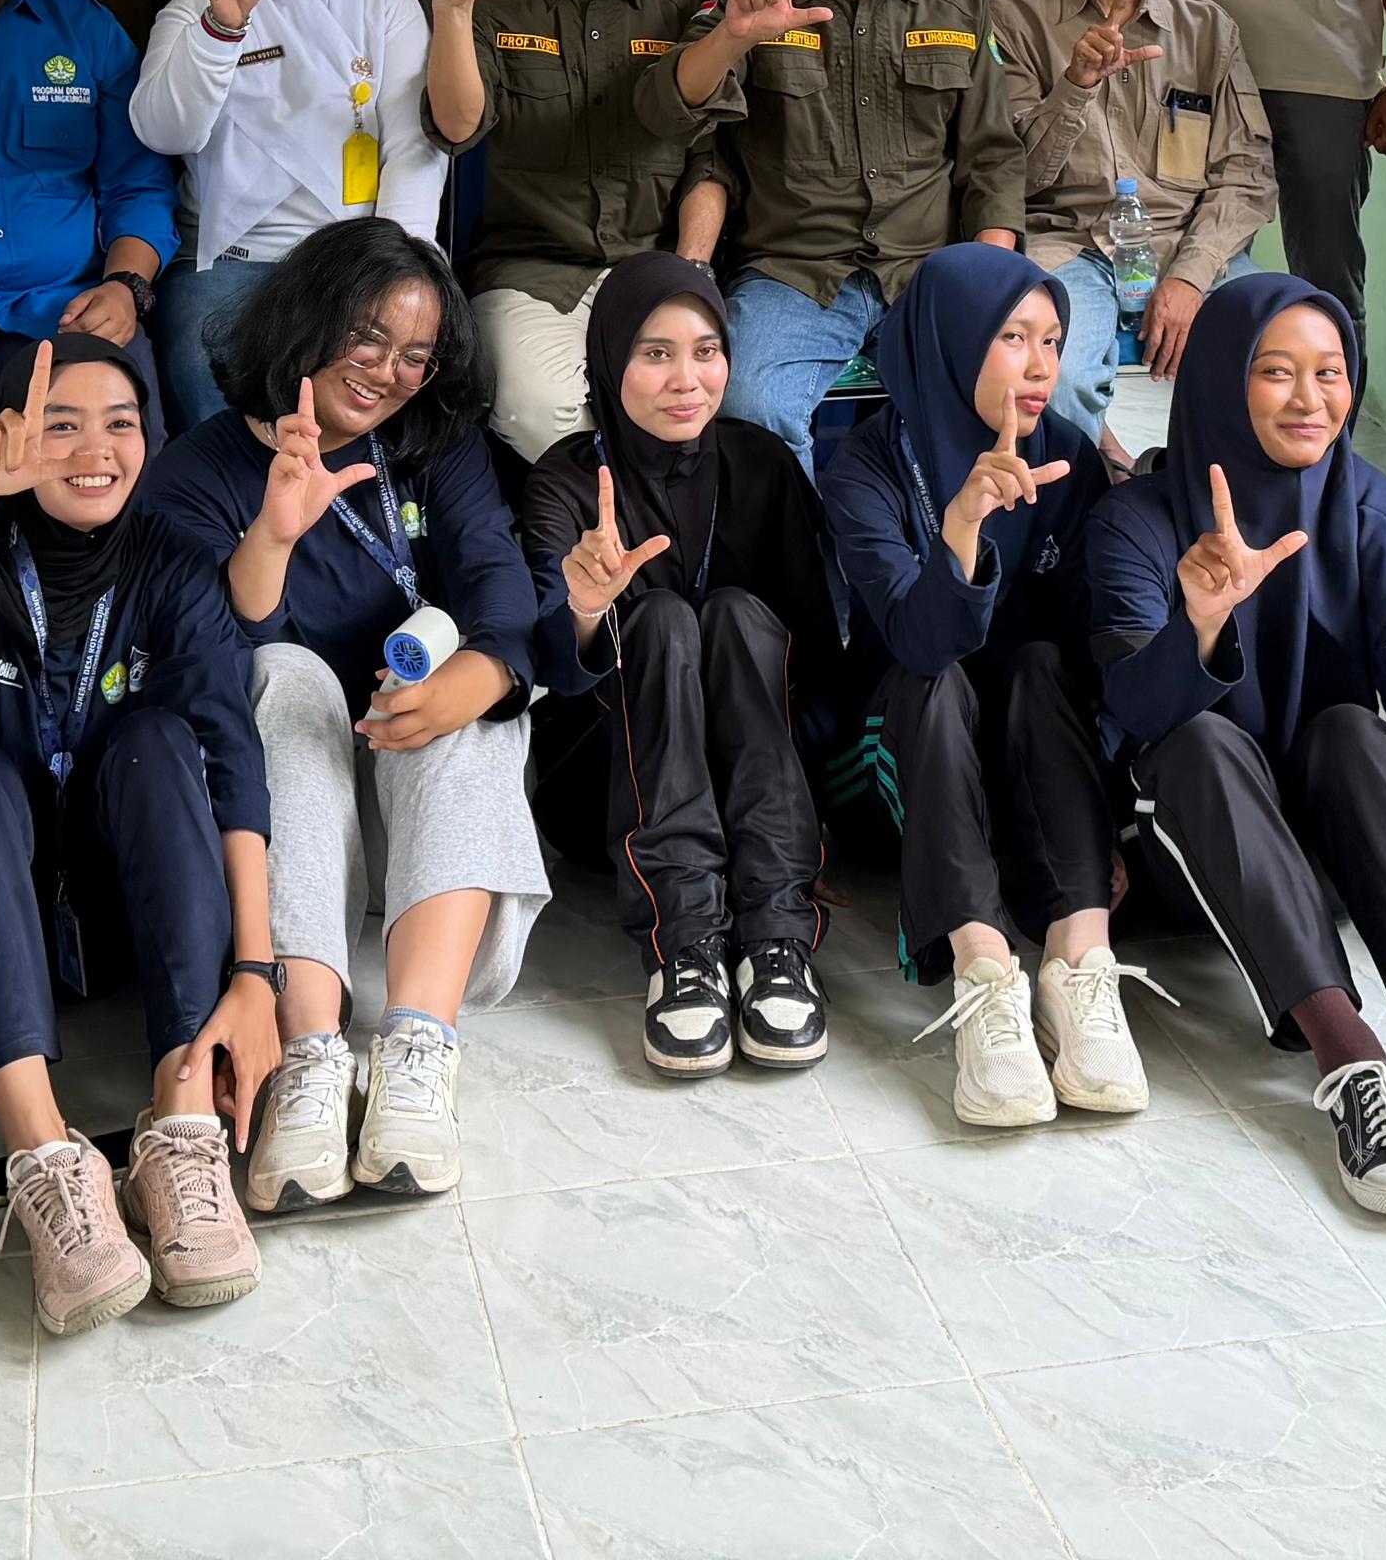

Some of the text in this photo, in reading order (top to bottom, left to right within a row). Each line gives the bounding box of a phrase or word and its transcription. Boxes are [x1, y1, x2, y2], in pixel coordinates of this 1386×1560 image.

[501, 36, 529, 48] PROF
[31, 86, 91, 96] PROGRAM DOKTOR
[51, 95, 91, 104] LINGKUNGAN
[31, 590, 44, 626] KUKERTA
[88, 632, 99, 654] KOTO
[84, 655, 93, 676] DESA
[74, 685, 89, 713] KUKERTA
